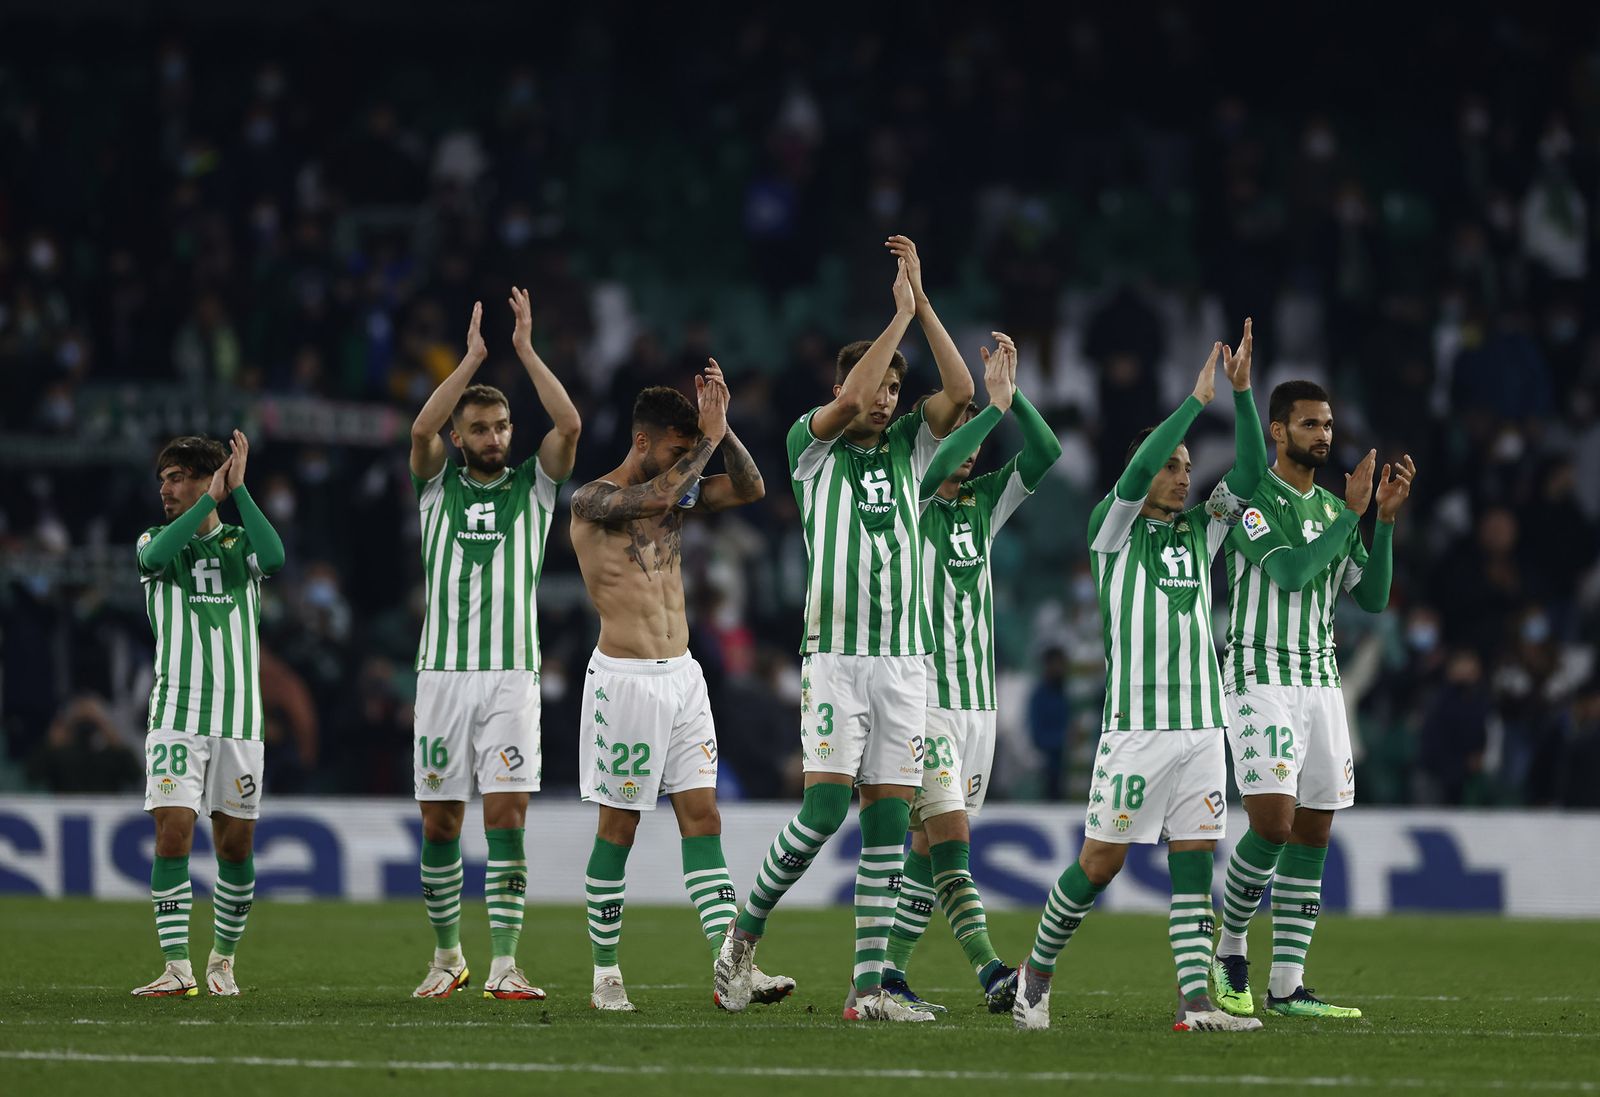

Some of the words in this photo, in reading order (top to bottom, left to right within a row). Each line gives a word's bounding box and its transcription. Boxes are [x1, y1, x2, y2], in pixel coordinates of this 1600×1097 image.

[858, 498, 898, 513] netwok
[457, 531, 504, 540] network
[189, 594, 234, 604] network
[816, 703, 834, 737] 3
[152, 743, 188, 777] 28
[419, 736, 449, 769] 16
[610, 743, 651, 777] 22
[923, 736, 954, 770] 33
[1263, 725, 1294, 761] 12
[1110, 773, 1146, 811] 18
